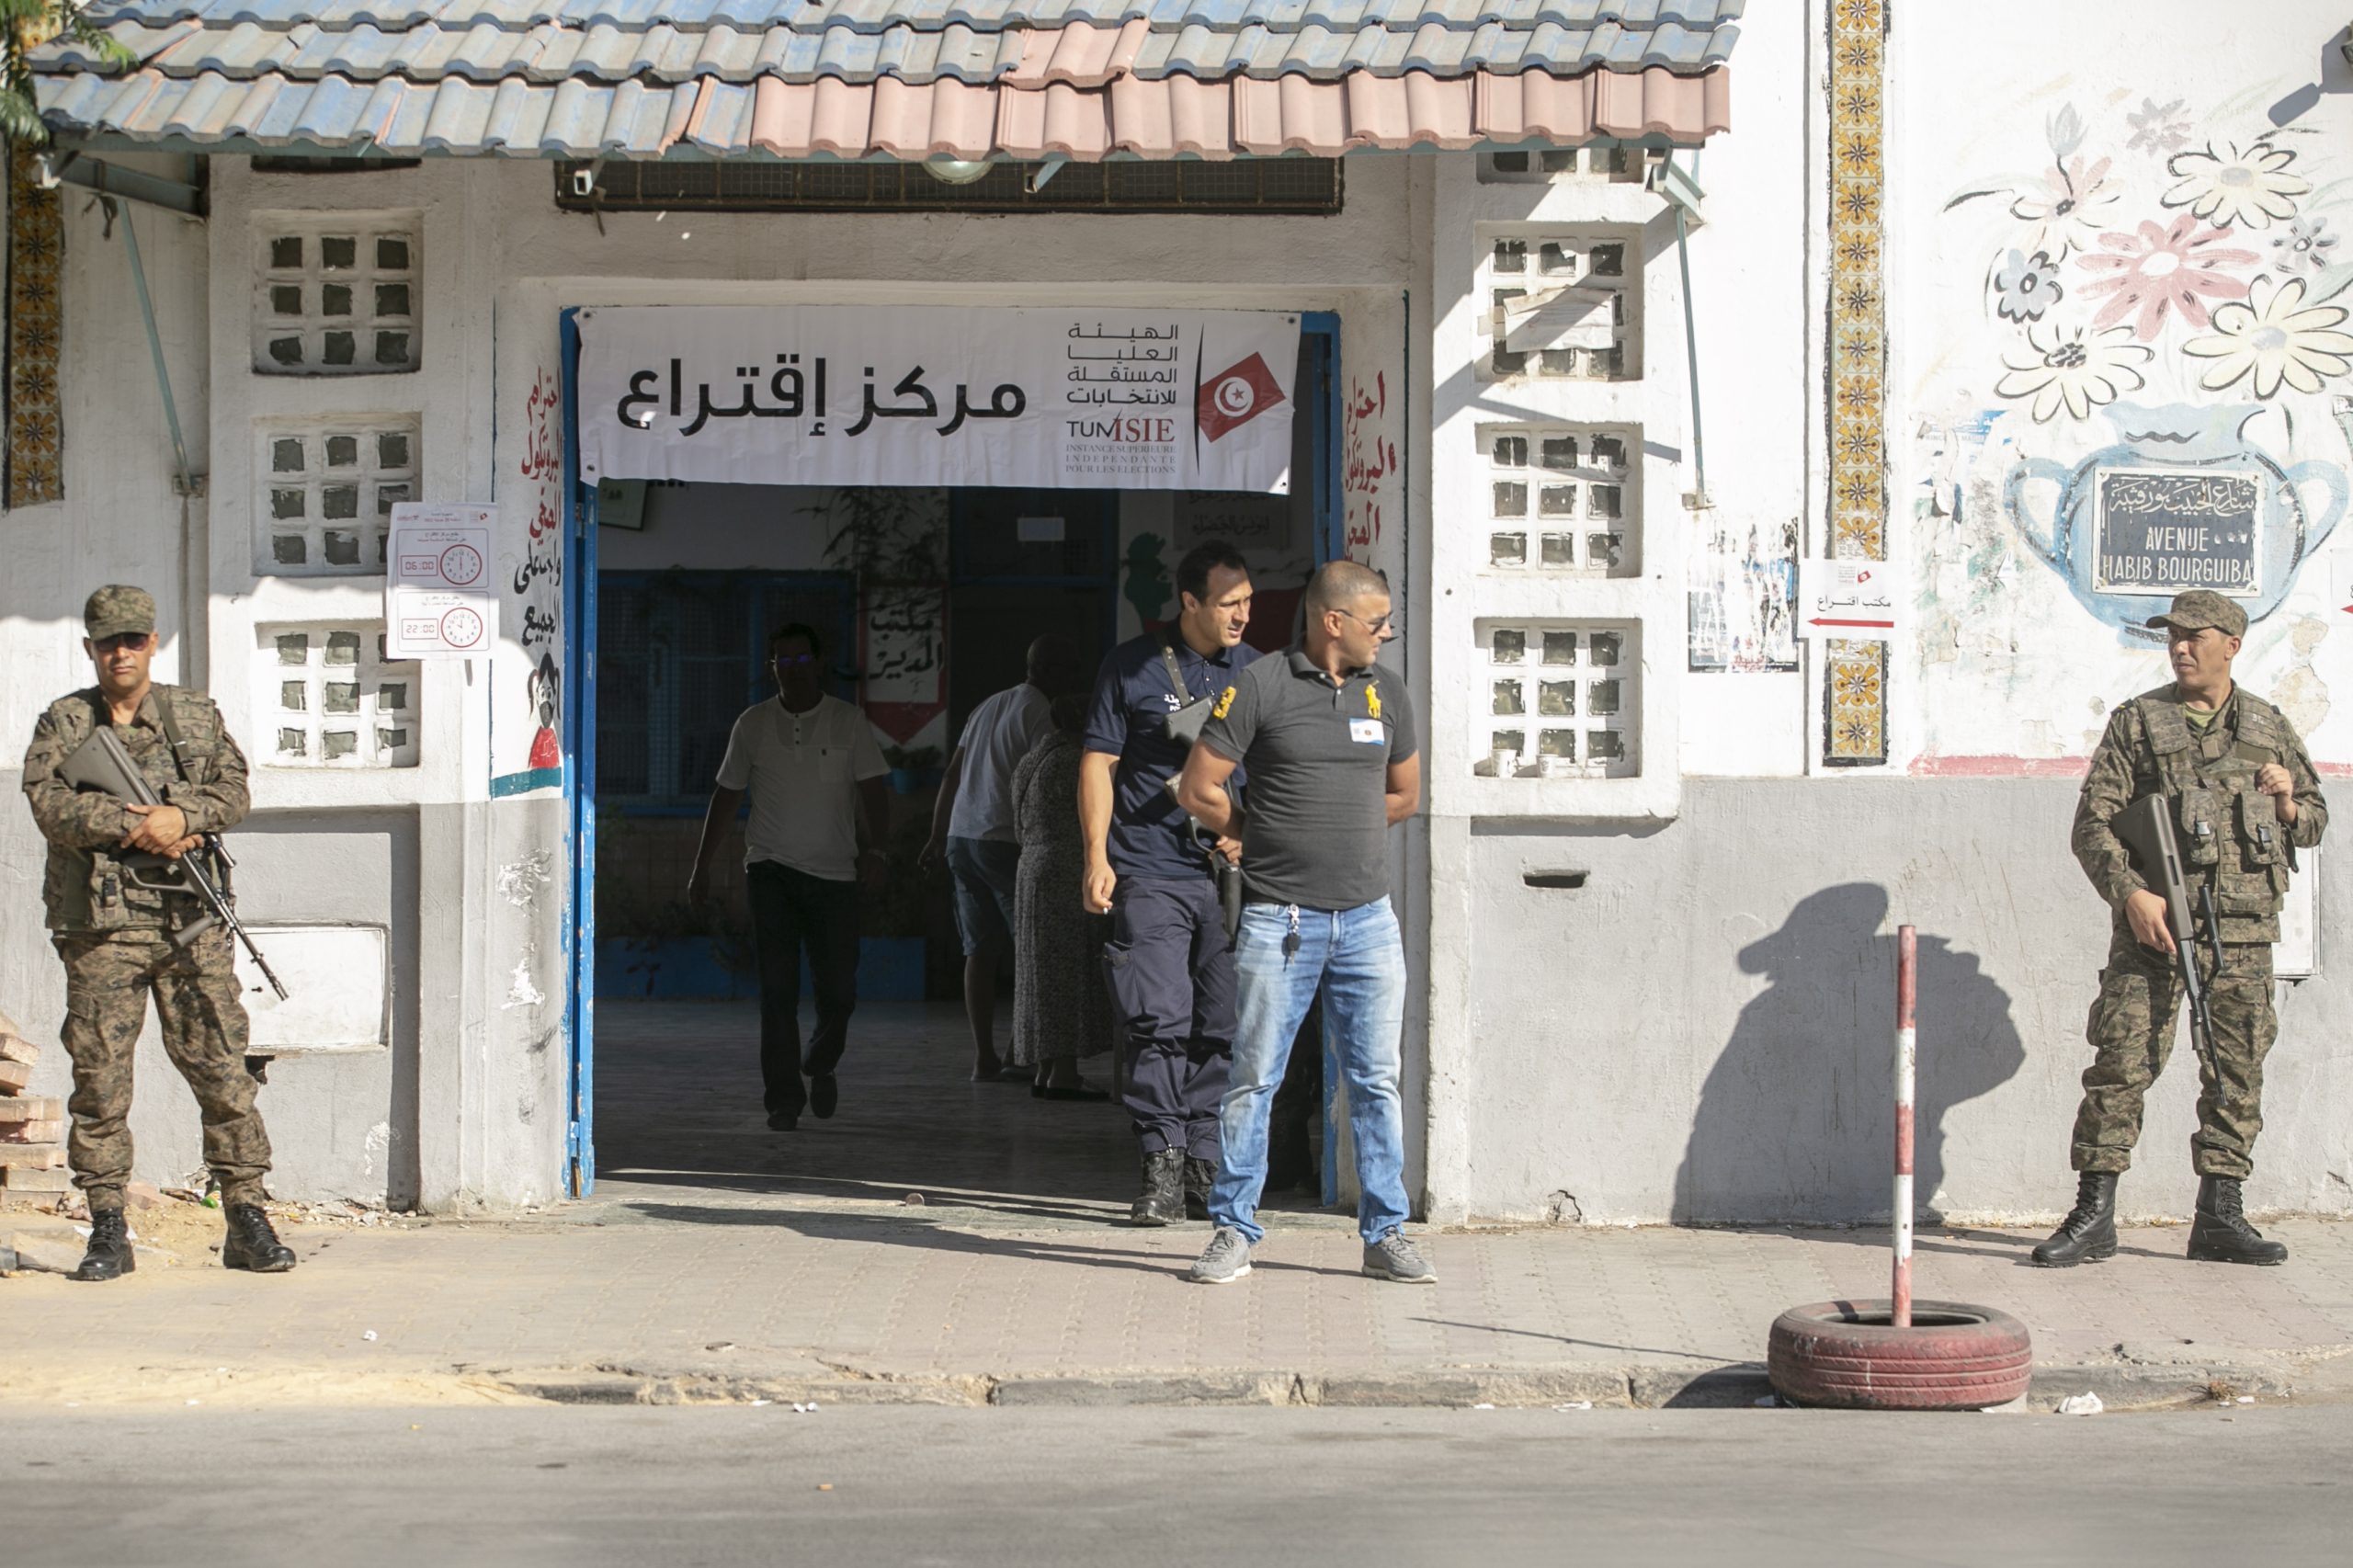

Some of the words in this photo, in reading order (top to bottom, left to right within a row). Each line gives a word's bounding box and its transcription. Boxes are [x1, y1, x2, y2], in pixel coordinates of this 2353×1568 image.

[1068, 323, 1178, 343] الهيئة
[1068, 344, 1177, 364] العليا
[1067, 366, 1177, 383] المستقلة
[617, 353, 826, 437] إقتراع
[845, 364, 1027, 437] مركز
[1066, 388, 1176, 407] للانتخابات
[1066, 407, 1176, 442] TUNISIE
[1066, 444, 1116, 453] INSTANCE
[1116, 444, 1176, 454] SUPERIEURE
[1066, 454, 1176, 463] INDEPENDANTE
[1066, 464, 1094, 473] POUR
[1096, 464, 1115, 473] LES
[1117, 464, 1176, 473] ELECTIONS
[2145, 527, 2210, 551] AVENUE
[2103, 555, 2153, 581] HABIB
[2157, 556, 2253, 583] BOURGUIBA
[1817, 596, 1859, 612] اقتراع
[1862, 596, 1892, 609] مكتب
